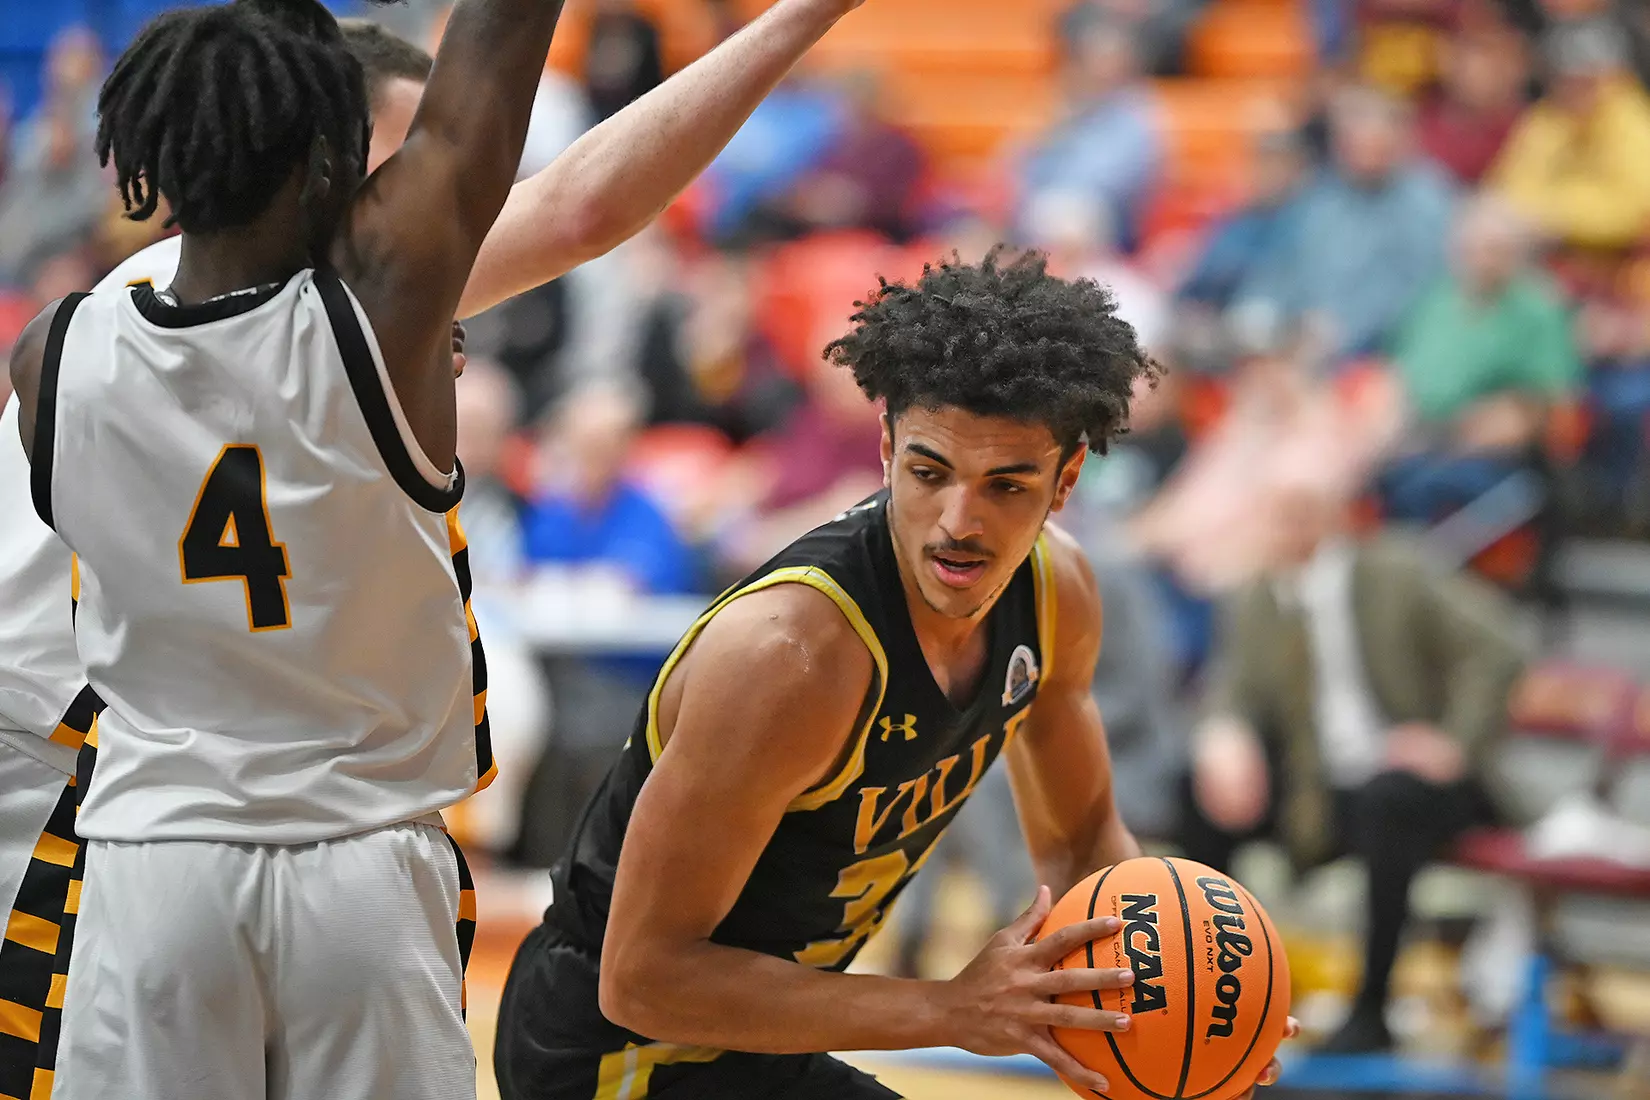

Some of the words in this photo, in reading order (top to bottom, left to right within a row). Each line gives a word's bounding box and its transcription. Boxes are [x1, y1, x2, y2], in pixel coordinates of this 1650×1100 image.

[178, 443, 293, 633] 4
[1120, 893, 1167, 1014] NCAA
[1195, 876, 1253, 1037] Wilson
[1203, 920, 1213, 943] EVO
[1206, 947, 1214, 972] NXT
